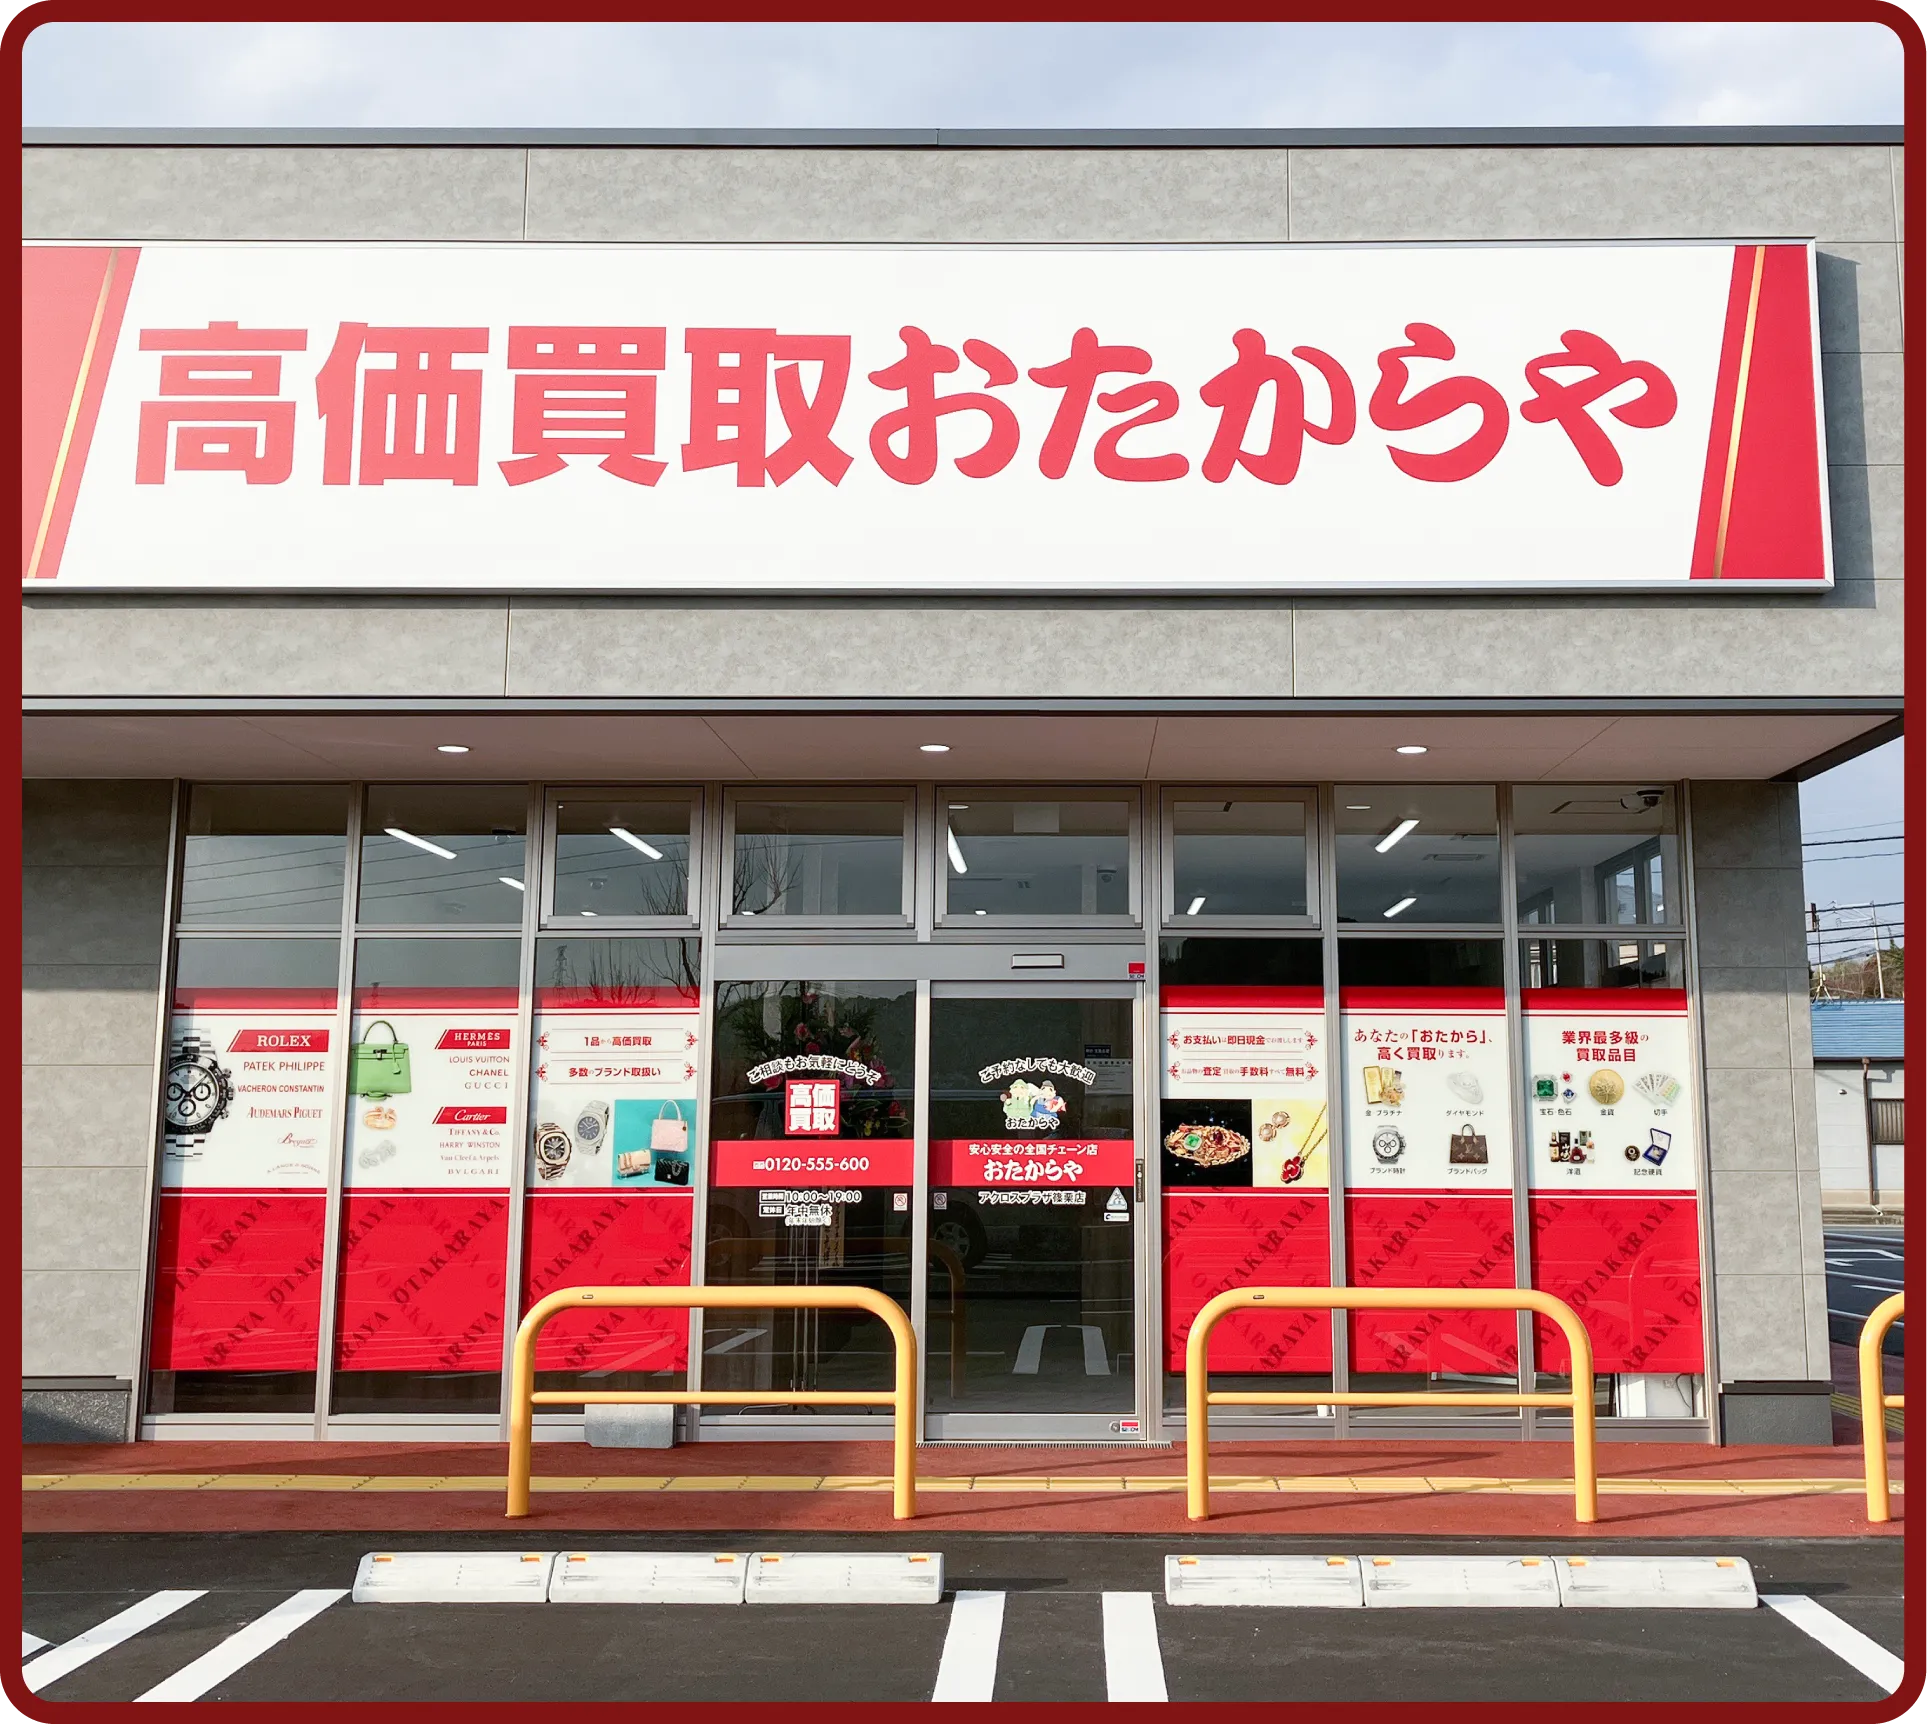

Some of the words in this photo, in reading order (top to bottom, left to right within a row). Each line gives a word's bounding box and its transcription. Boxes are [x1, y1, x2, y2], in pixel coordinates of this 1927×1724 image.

[135, 321, 1678, 487] 高価買取おたからや
[256, 1035, 311, 1047] ROLEX
[1562, 1030, 1649, 1045] 業界最多級の
[1576, 1048, 1636, 1062] 買取品目
[243, 1061, 275, 1071] PATEK
[279, 1061, 325, 1071] PHILIPPE
[789, 1084, 836, 1107] 高価
[247, 1106, 292, 1118] AUDEMARS
[293, 1106, 323, 1118] PIGUET
[454, 1109, 491, 1121] Cartier
[1446, 1109, 1485, 1117] ダイヤモンド
[789, 1107, 836, 1131] 買取
[1005, 1117, 1059, 1129] おたからや
[449, 1128, 481, 1136] TIFFANY
[969, 1143, 1098, 1155] 安心安全の全国チェーン店
[765, 1157, 869, 1171] 0120-555-600
[983, 1159, 1083, 1182] おたからや
[786, 1204, 833, 1216] 年中無休
[392, 1199, 505, 1305] OTAKARAYA
[1570, 1201, 1675, 1307] OTAKARAYA
